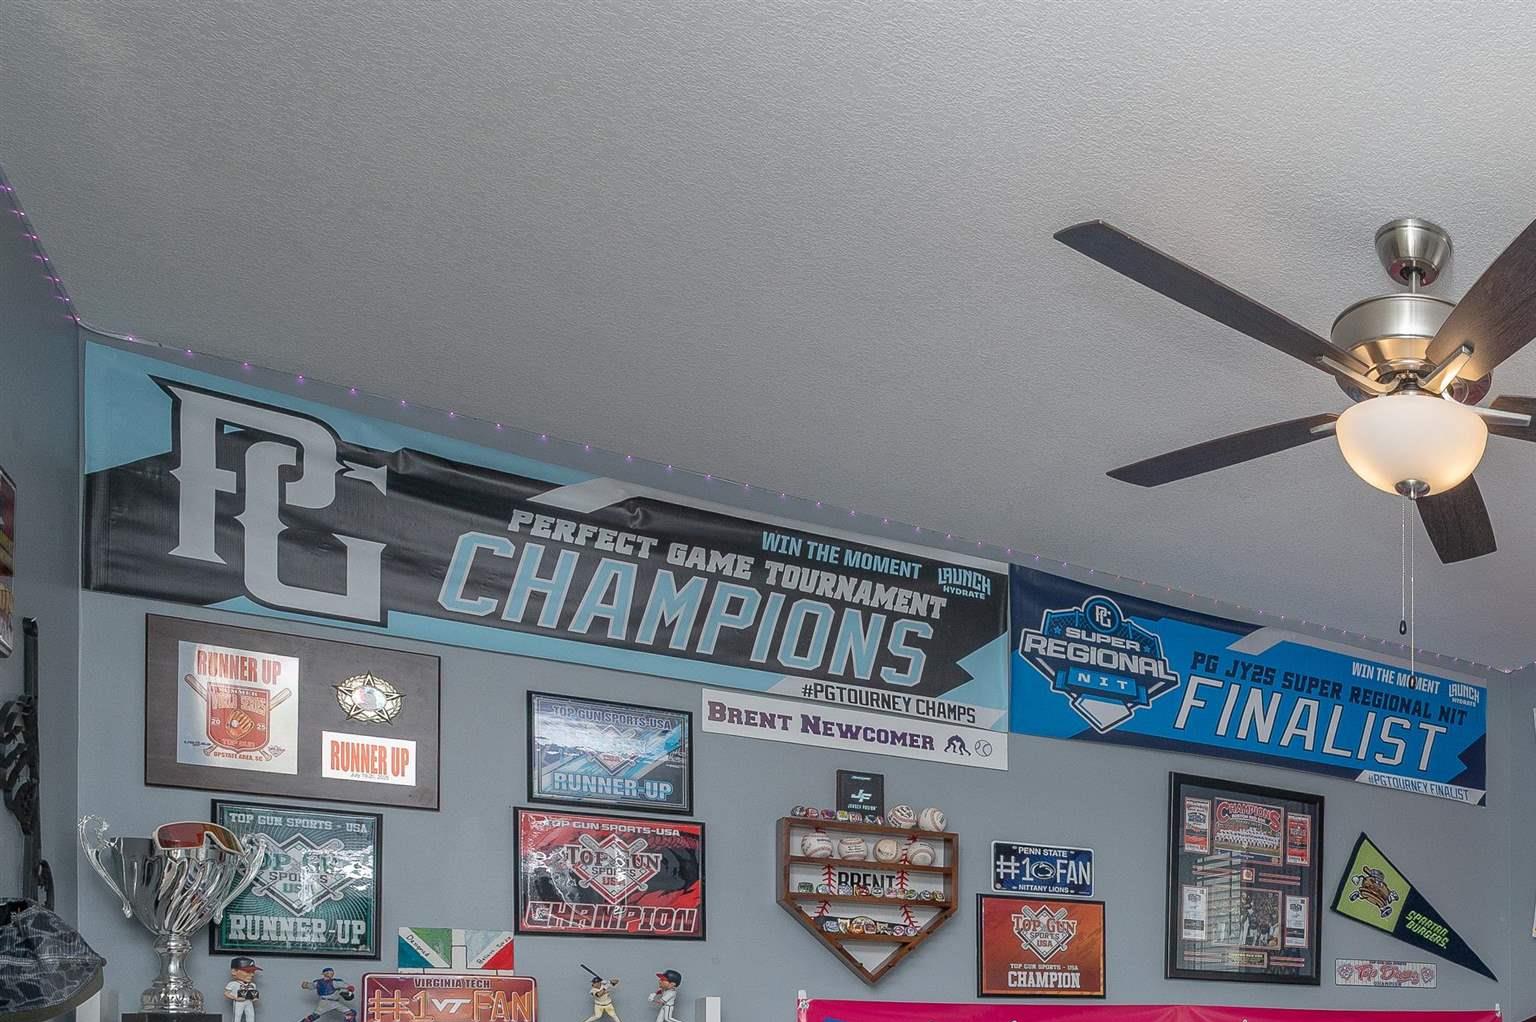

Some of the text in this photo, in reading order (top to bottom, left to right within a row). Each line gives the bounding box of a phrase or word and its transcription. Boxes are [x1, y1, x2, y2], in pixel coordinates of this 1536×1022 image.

[507, 508, 948, 620] PERFECT GAME TOURNAMENT
[762, 531, 923, 579] WIN THE MOMENT
[937, 566, 992, 598] LAUNCH
[942, 586, 987, 600] HYDRATE
[438, 530, 936, 688] CHAMPIONS
[1065, 627, 1141, 651] SUPER
[197, 649, 283, 685] RUNNER UP
[1024, 634, 1177, 681] REGIONAL
[1190, 651, 1468, 726] PG JY25 SUPER REGIONAL NIT
[1352, 661, 1440, 695] WIN THE MMENT
[801, 682, 977, 724] #PGTOURNEY CHAMPS
[1448, 683, 1480, 704] LAUNCH
[552, 705, 577, 717] TOP
[578, 709, 601, 721] GUN
[707, 700, 936, 751] BRENT NEWCOMER
[1173, 674, 1447, 772] FINALIST
[330, 740, 410, 777] RUNNER UP
[553, 772, 673, 801] RUNNER-UP
[1368, 772, 1470, 801] #PGTOURNEY FINALIST
[229, 812, 254, 824] TOP
[257, 815, 283, 826] GUN
[286, 818, 333, 830] SPORTS
[346, 823, 367, 833] USA
[572, 822, 600, 831] GUN
[1216, 801, 1281, 832] CHAMPIONS
[1018, 847, 1068, 858] PENN STATE
[837, 872, 897, 890] BRENT
[996, 855, 1034, 881] #1
[1056, 859, 1091, 886] FAN
[1018, 884, 1070, 894] NITTANY LIONS
[228, 914, 366, 945] RUNNER-UP
[526, 901, 697, 933] CHAMPION
[1012, 915, 1076, 934] TOP GUN
[1029, 932, 1060, 940] SPORTS
[1036, 939, 1053, 948] USA
[414, 977, 491, 988] VIRGINIA TECH
[1008, 971, 1080, 989] CHAMPION
[431, 998, 472, 1014] VT
